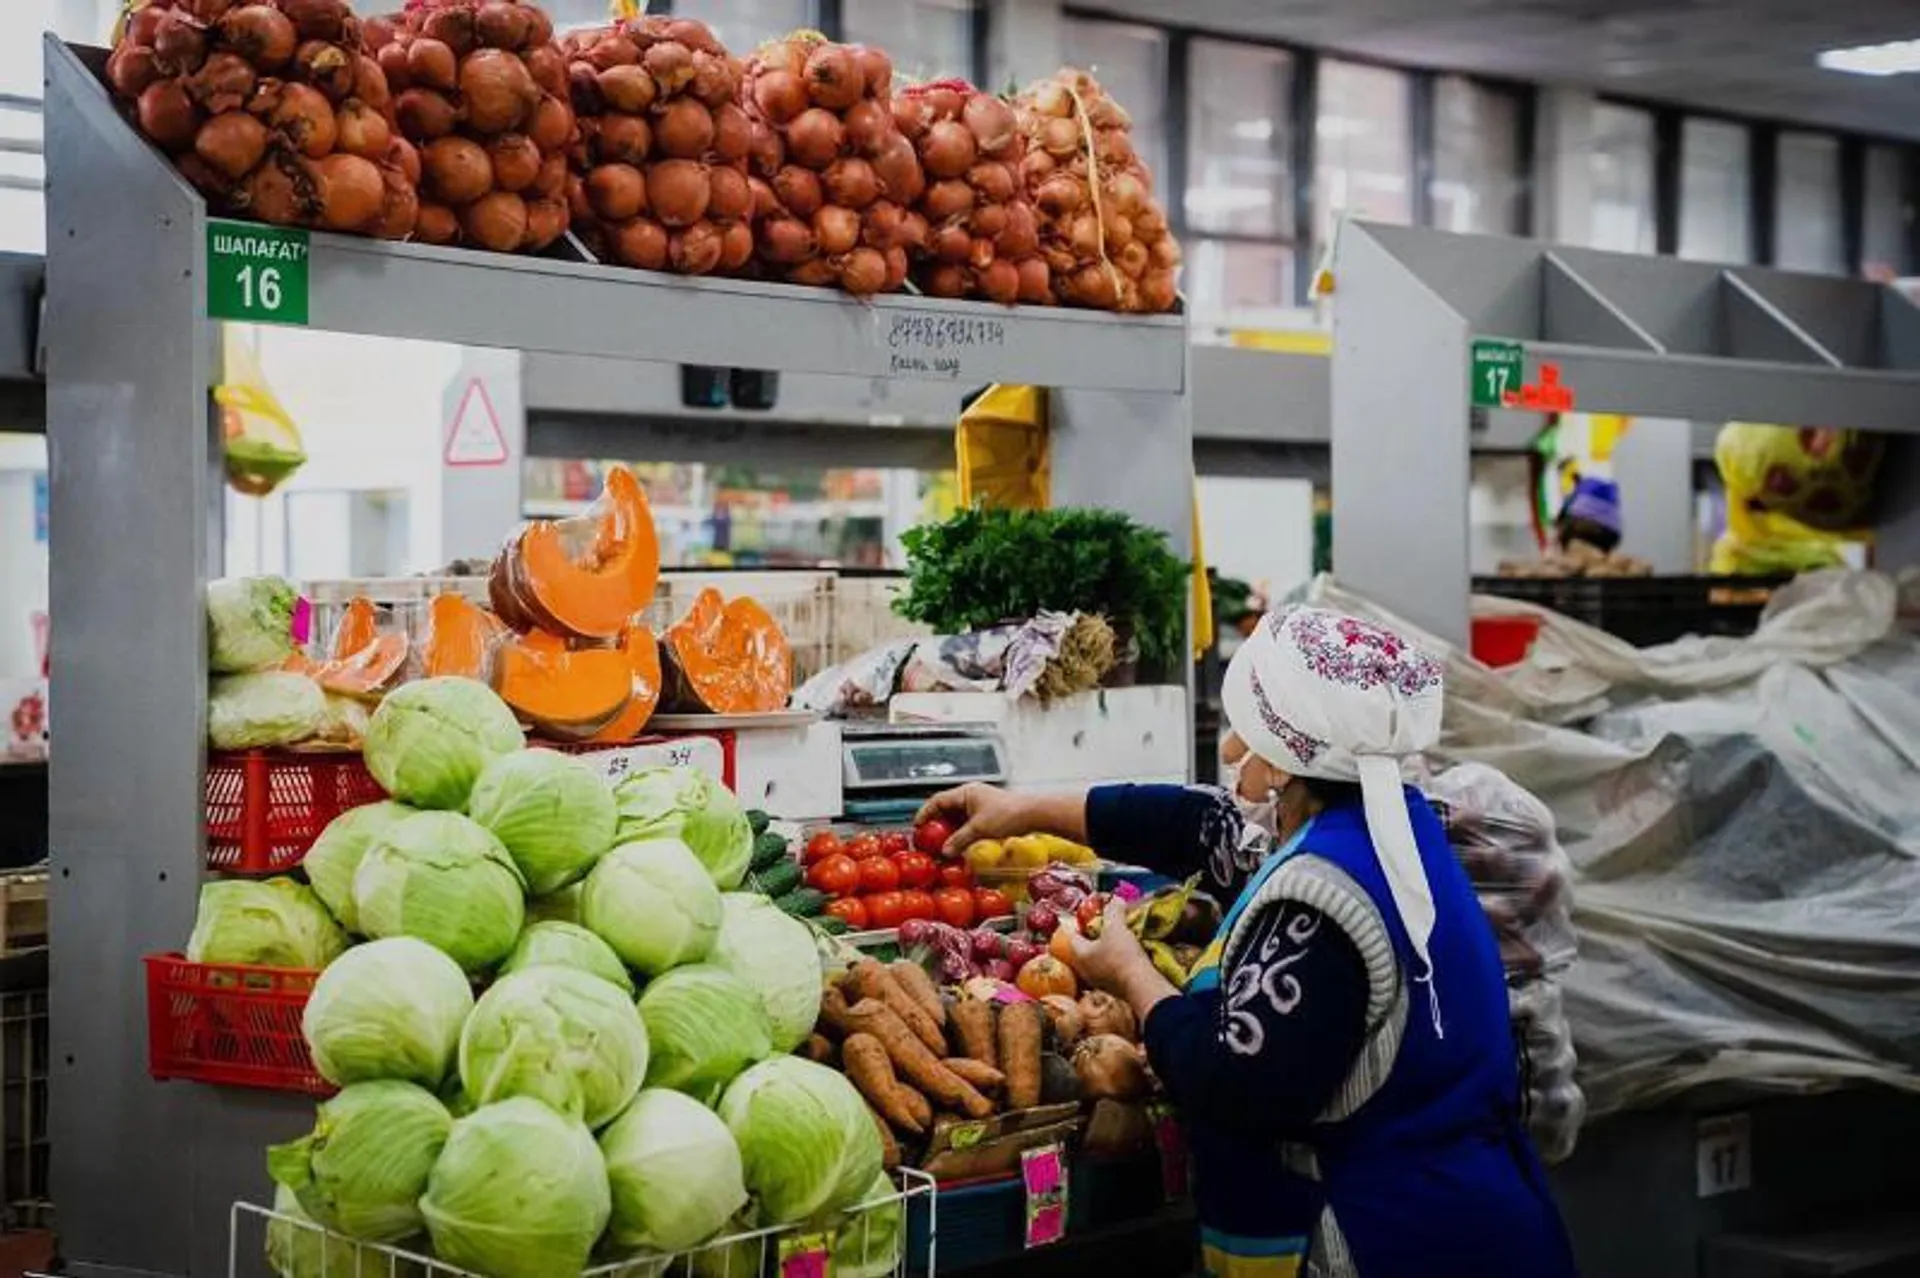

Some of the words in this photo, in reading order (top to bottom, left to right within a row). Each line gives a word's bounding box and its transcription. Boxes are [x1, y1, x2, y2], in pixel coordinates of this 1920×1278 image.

[235, 264, 282, 310] 16
[1485, 366, 1509, 398] 17
[1711, 1143, 1741, 1185] 17
